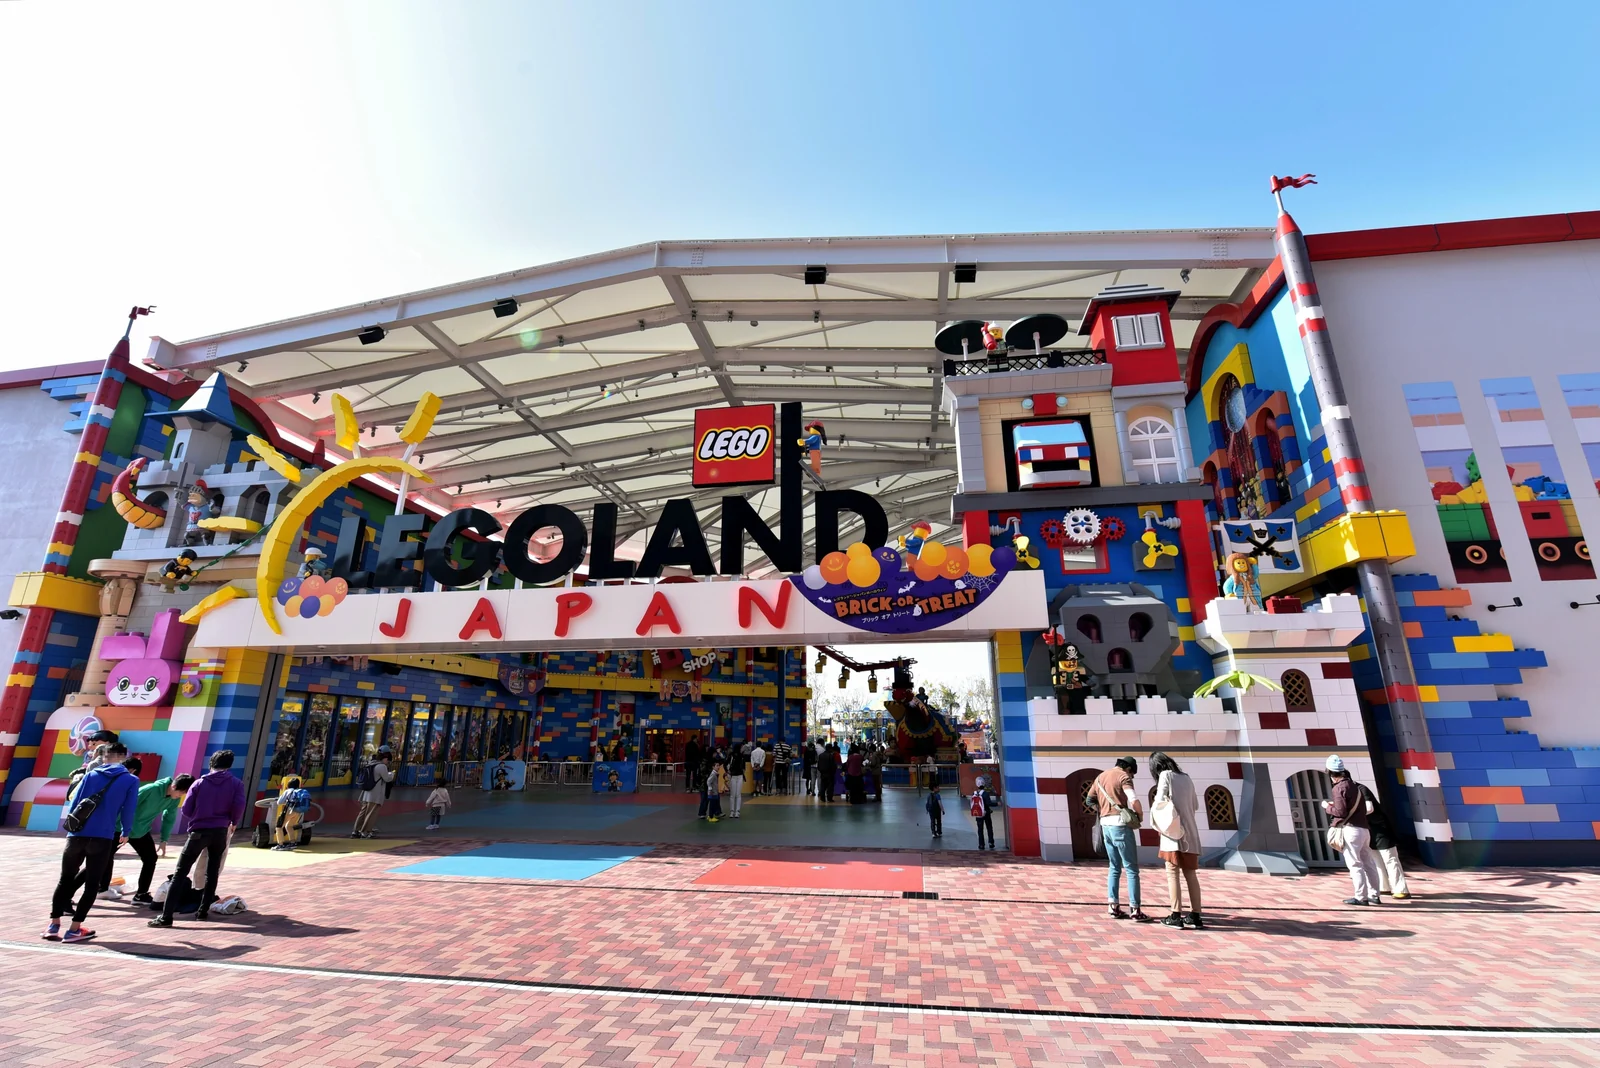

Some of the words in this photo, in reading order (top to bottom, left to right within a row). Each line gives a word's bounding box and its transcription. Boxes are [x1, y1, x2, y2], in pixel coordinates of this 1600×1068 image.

[698, 426, 769, 460] LEGO
[331, 401, 889, 588] LEGOLAND
[379, 580, 792, 640] JAPAN
[682, 652, 716, 673] SHOP
